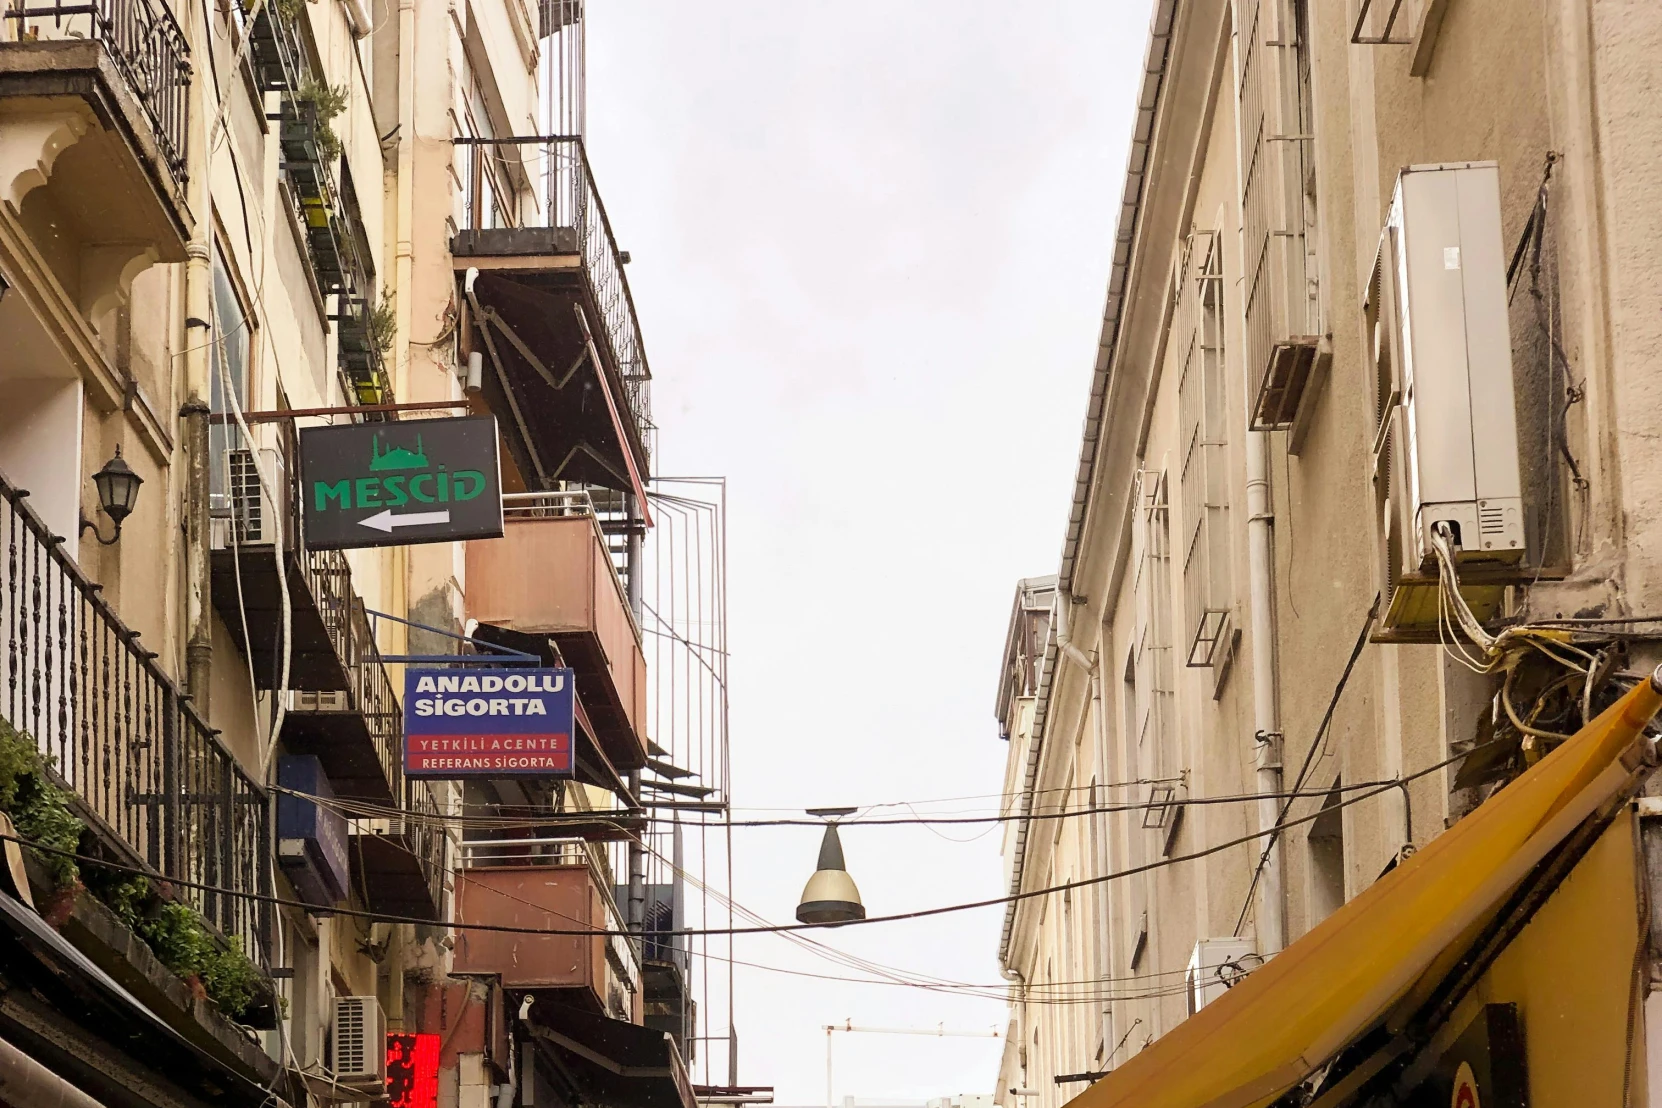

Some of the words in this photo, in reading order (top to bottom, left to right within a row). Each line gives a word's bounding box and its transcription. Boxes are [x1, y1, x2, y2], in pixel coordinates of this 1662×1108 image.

[314, 465, 486, 511] MESCİD
[415, 675, 564, 692] ANADOLU
[415, 694, 547, 716] SİGORTA
[420, 737, 485, 750] YETKİLİ
[491, 739, 557, 749] ACENTE
[422, 757, 491, 768] REFERANS
[495, 755, 555, 767] SİGORTA
